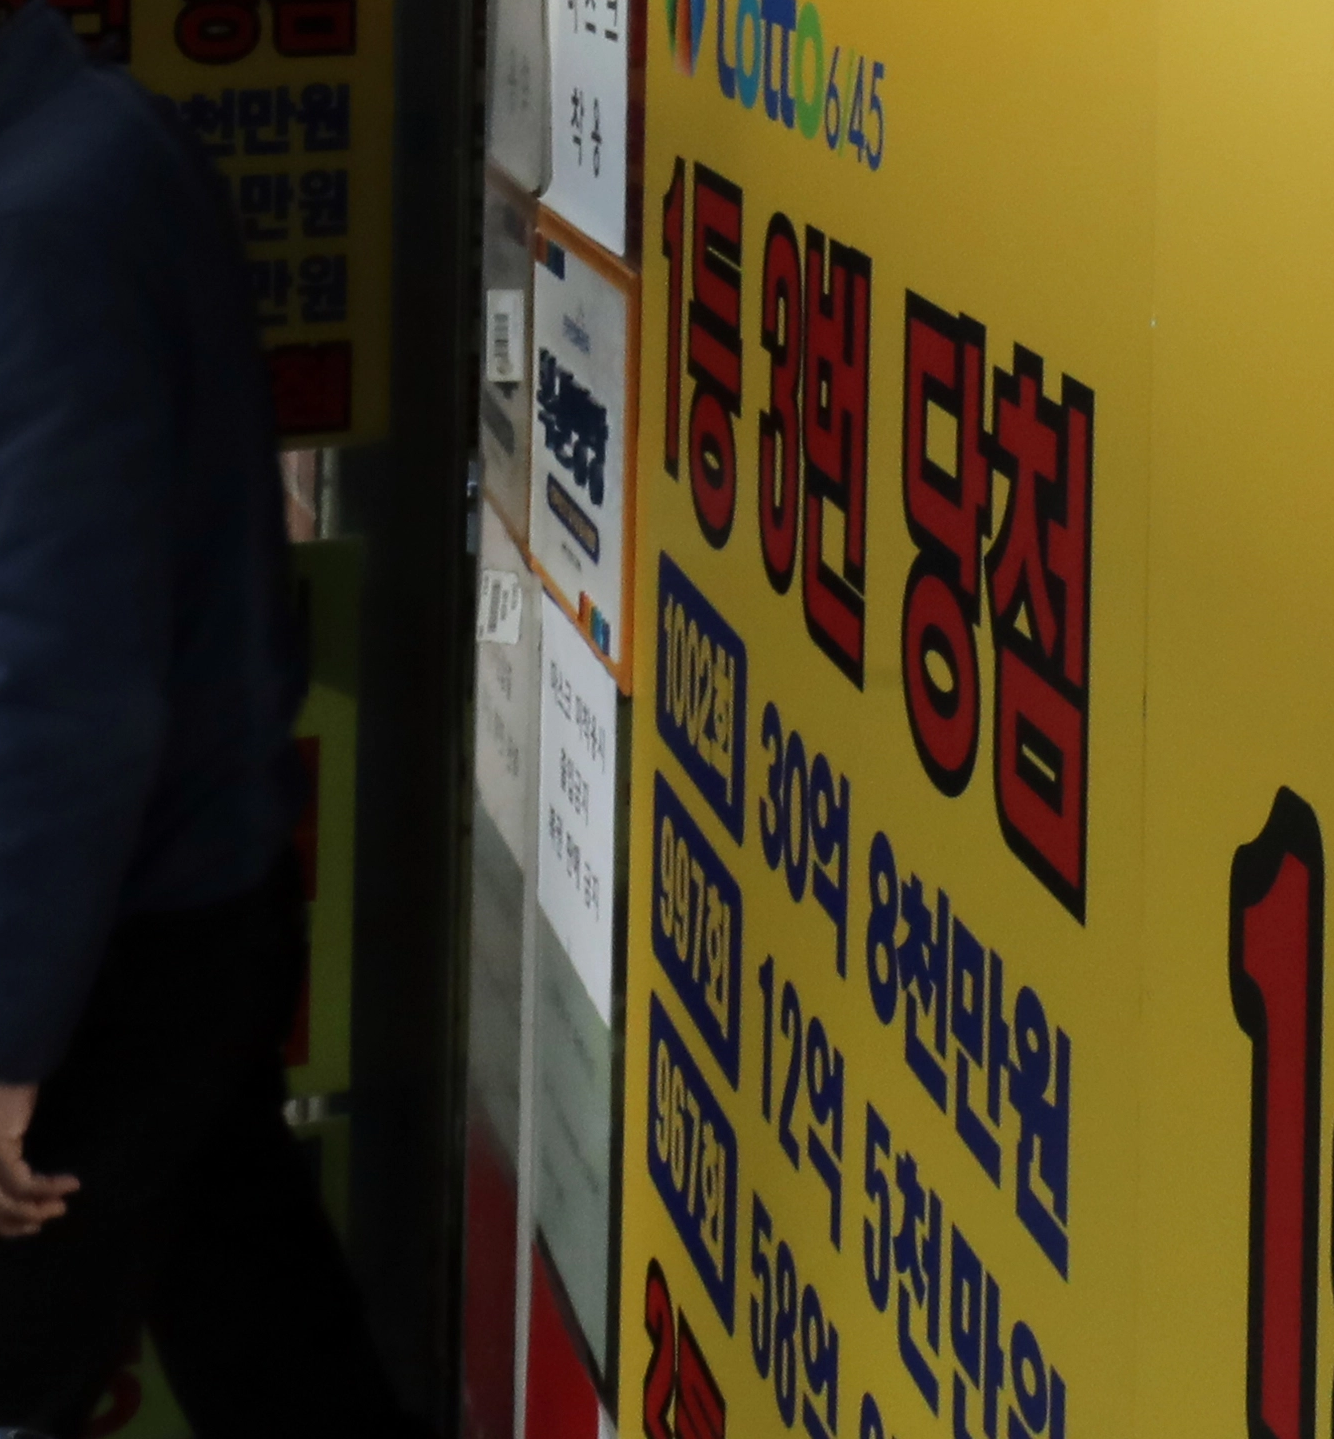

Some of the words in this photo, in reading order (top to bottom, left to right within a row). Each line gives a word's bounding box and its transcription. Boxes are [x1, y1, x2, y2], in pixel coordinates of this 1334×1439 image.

[172, 82, 352, 159] 천만원
[571, 85, 603, 180] 착용
[662, 156, 744, 551] 1등
[758, 211, 873, 694] 3번
[900, 287, 1095, 928] 당첨
[659, 814, 733, 1044] 997회
[758, 954, 845, 1254] 12억
[663, 589, 736, 807] 1002회
[759, 701, 851, 983] 30억
[867, 830, 1072, 1284] 8천만원
[654, 1035, 728, 1284] 967회
